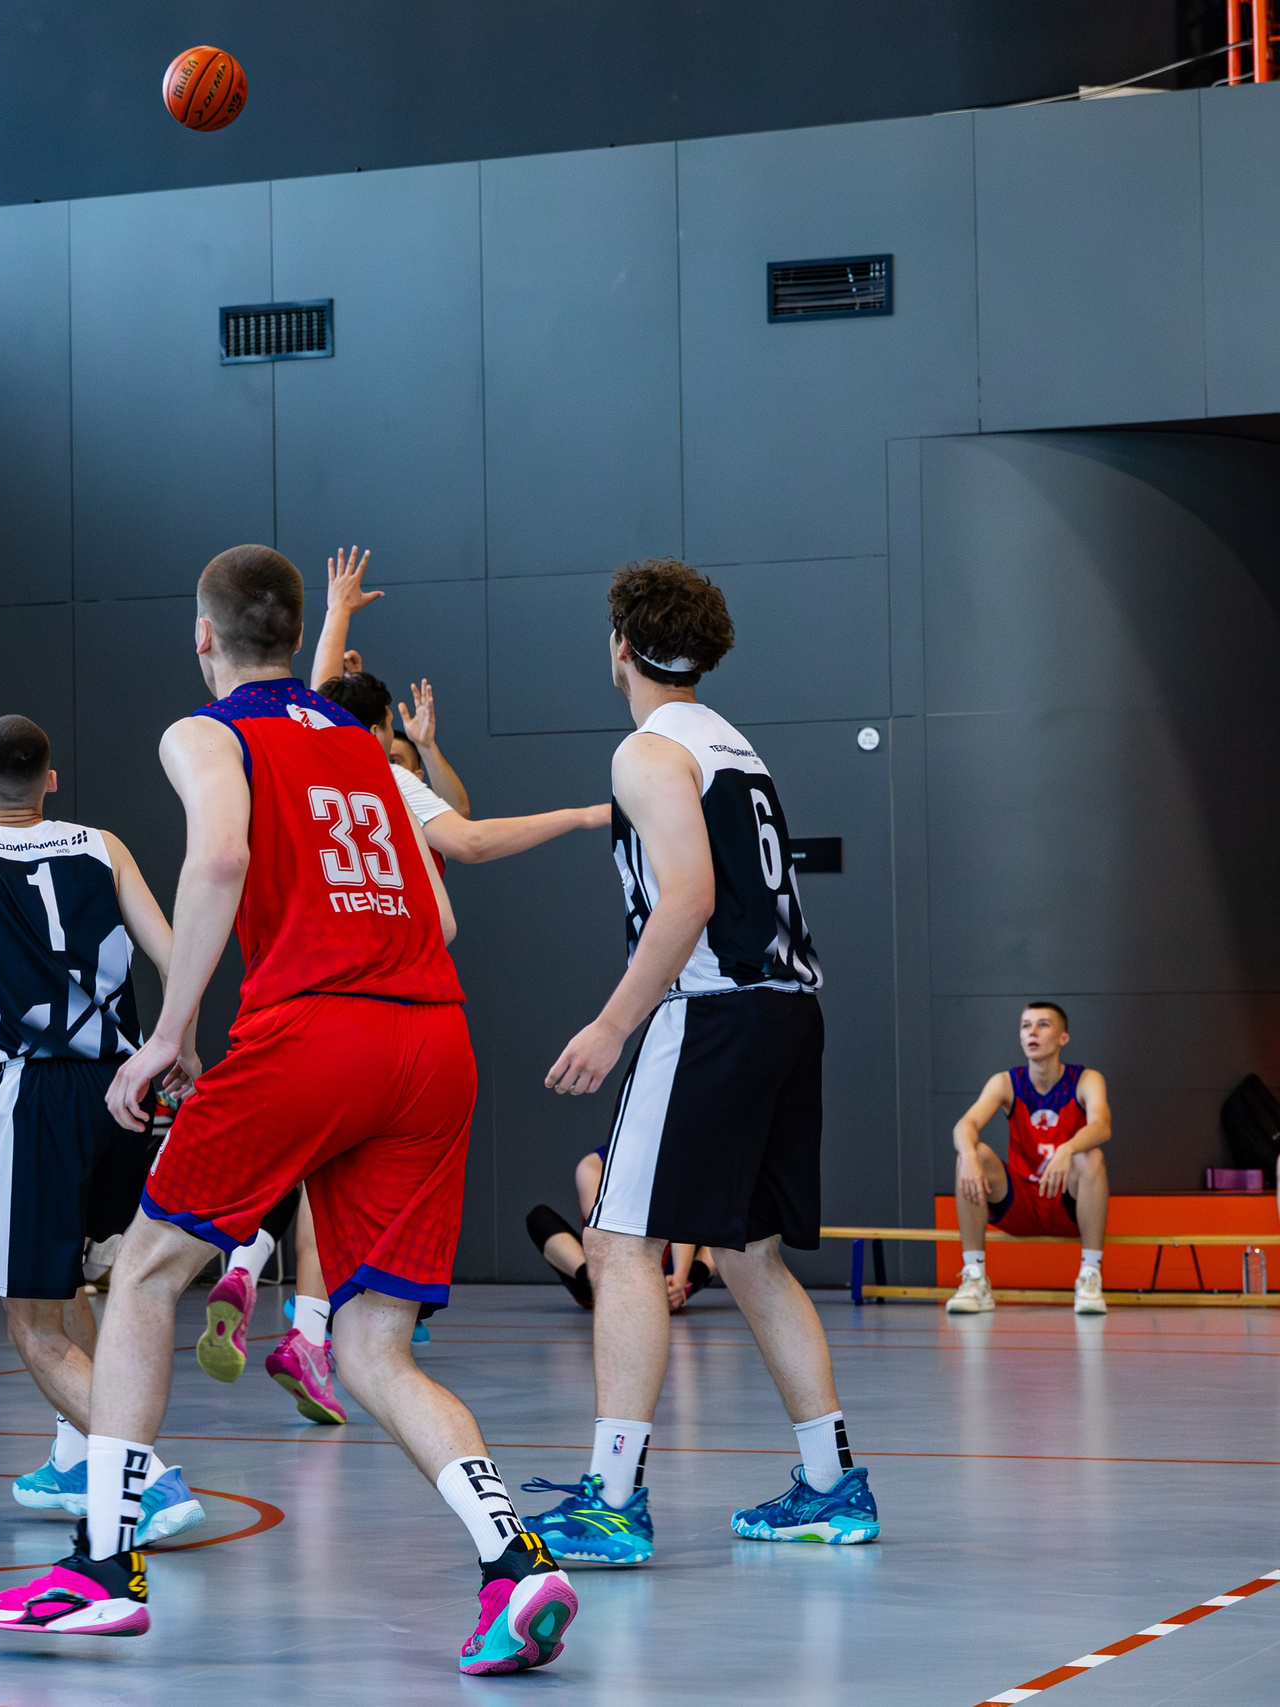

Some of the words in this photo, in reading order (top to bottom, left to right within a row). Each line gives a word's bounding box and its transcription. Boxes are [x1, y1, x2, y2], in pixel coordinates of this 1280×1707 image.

[203, 63, 226, 108] DEMIX
[308, 785, 405, 890] 33
[749, 788, 783, 890] 6
[26, 862, 66, 951] 1
[329, 891, 411, 918] ПЕНЗА
